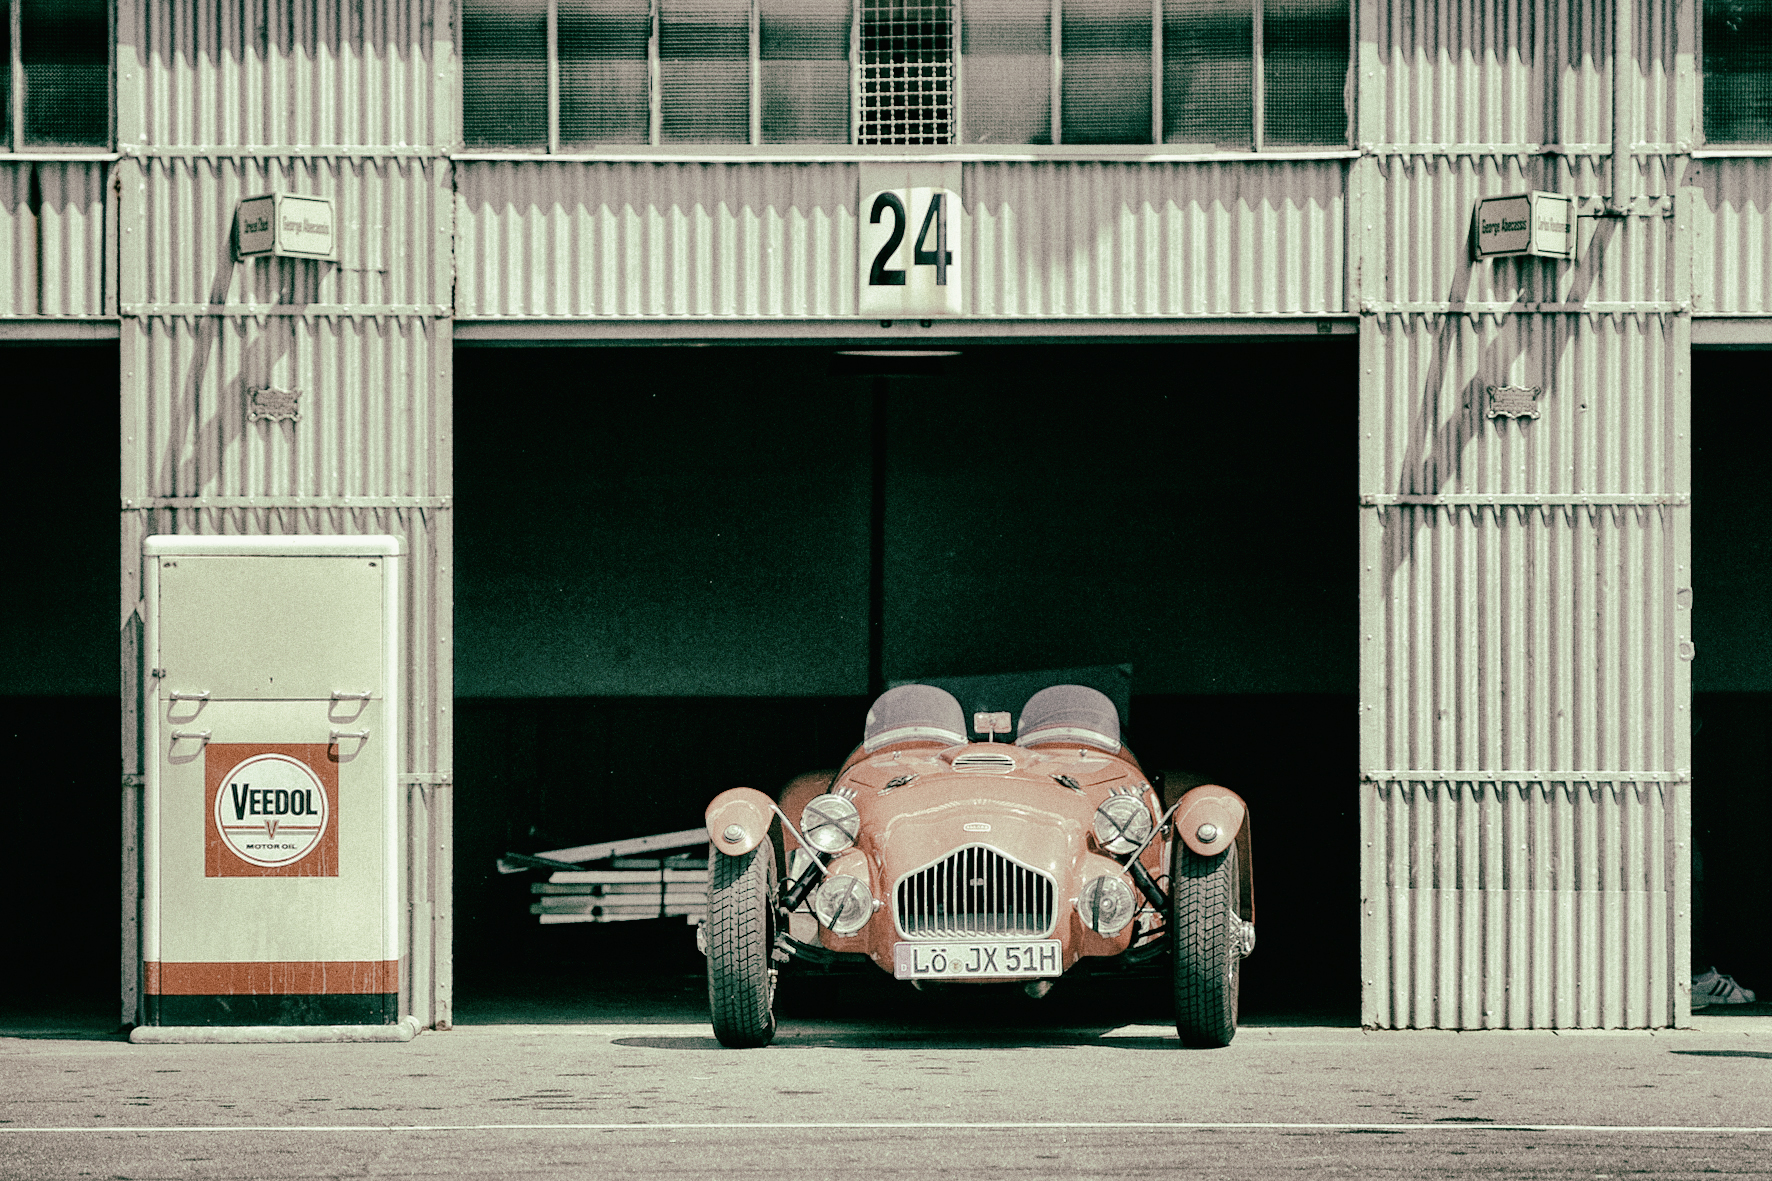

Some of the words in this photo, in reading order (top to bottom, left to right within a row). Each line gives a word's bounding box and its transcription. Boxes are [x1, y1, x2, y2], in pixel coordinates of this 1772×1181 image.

[868, 191, 953, 286] 24
[1482, 219, 1500, 236] George
[231, 783, 318, 820] VEEDOL
[965, 947, 998, 973] JX
[1005, 946, 1056, 972] 51H
